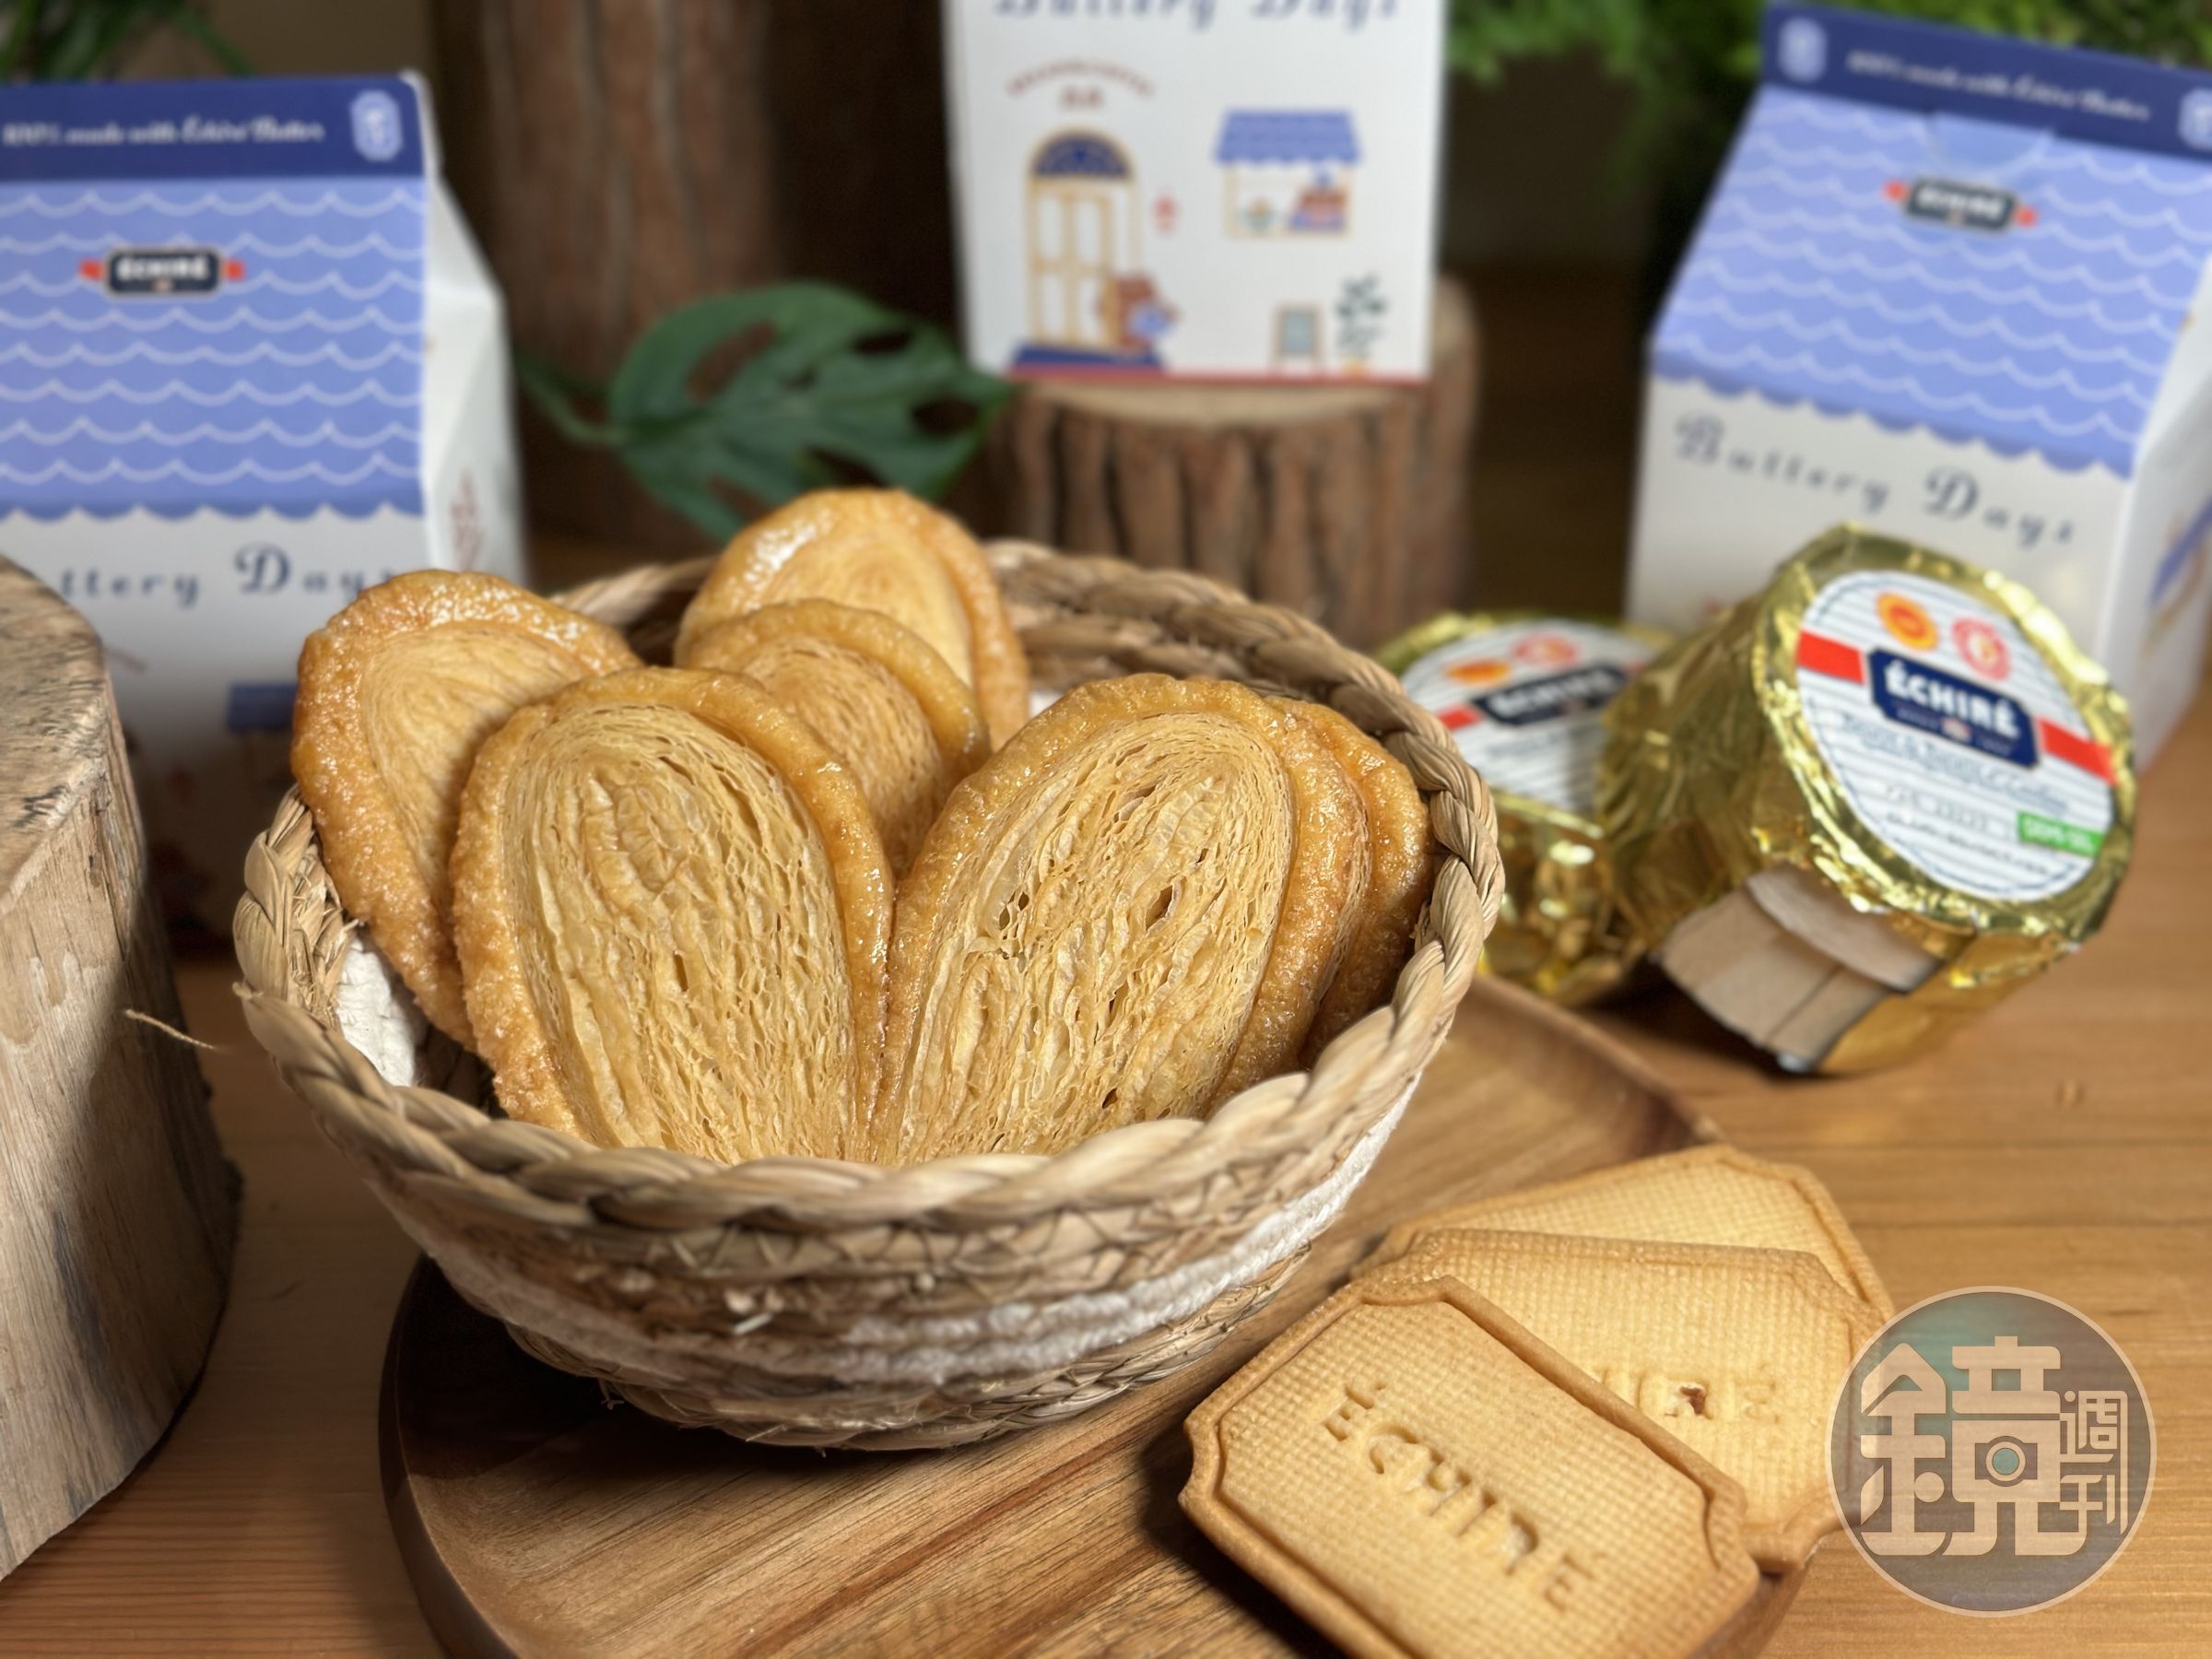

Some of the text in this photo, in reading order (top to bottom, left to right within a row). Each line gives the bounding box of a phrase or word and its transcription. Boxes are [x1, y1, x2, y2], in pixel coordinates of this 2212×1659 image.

[65, 120, 124, 146] made
[127, 118, 177, 144] with
[1673, 413, 2075, 547] Buttery Days
[1885, 658, 2022, 740] ÉCHIRÉ
